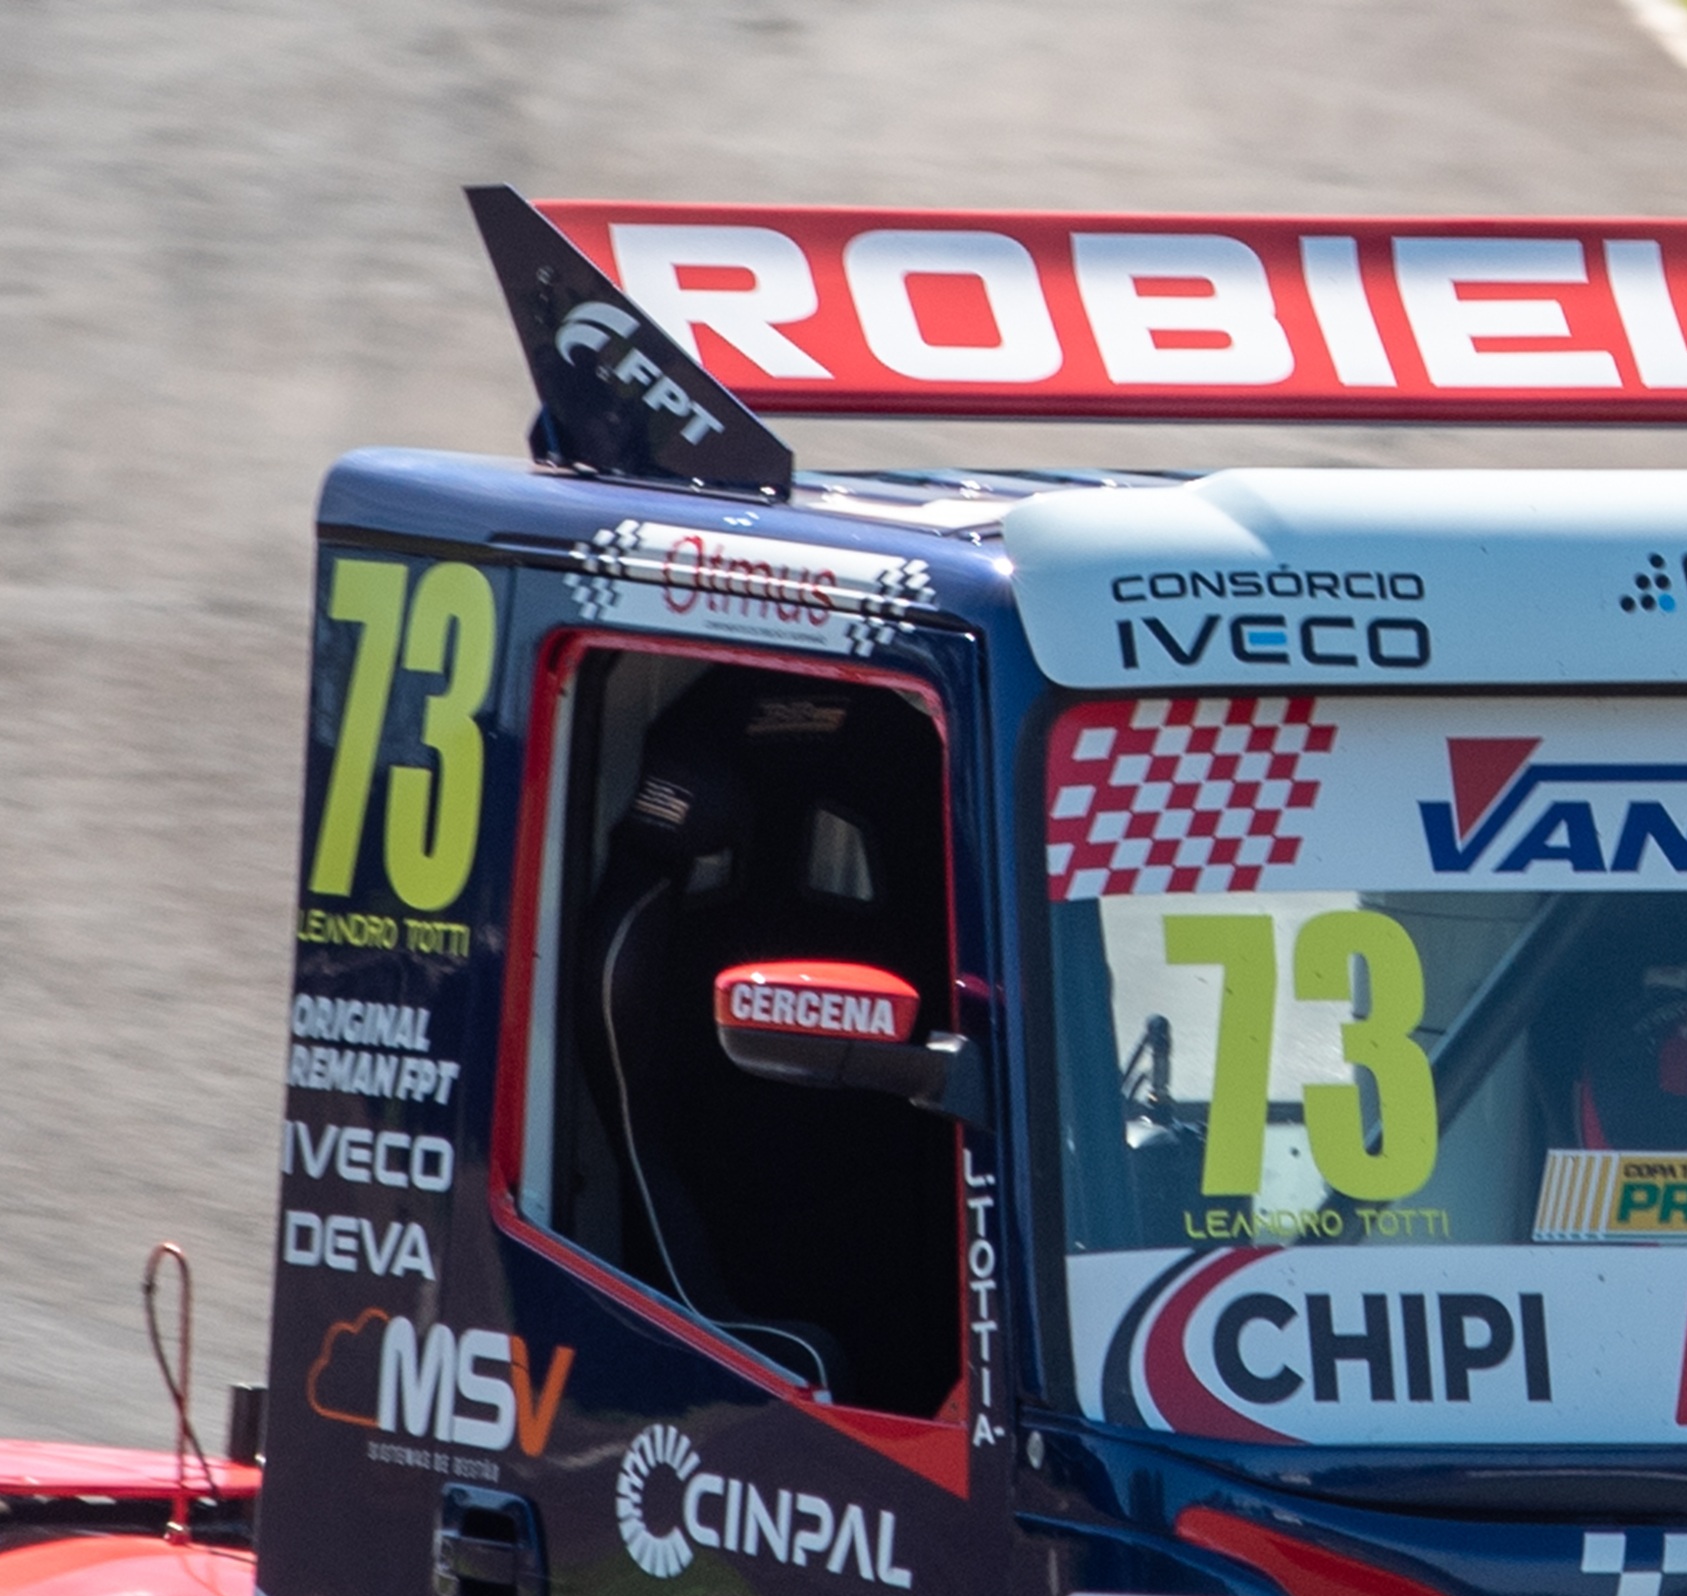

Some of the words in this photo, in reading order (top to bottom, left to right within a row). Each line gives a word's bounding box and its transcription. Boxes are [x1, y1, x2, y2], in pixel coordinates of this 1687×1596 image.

[615, 347, 725, 446] FPT
[665, 535, 837, 627] Otmus
[1111, 563, 1426, 602] CONSÓRCIO
[1116, 613, 1432, 670] IVECO
[309, 557, 497, 912] 73
[297, 908, 399, 949] LEANDRO
[403, 917, 471, 958] TOTTI
[292, 992, 431, 1053] ORIGINAL
[730, 983, 896, 1037] CERCENA
[287, 1043, 399, 1099] REMAN
[395, 1055, 461, 1106] FPT
[1161, 908, 1440, 1203] 73
[281, 1120, 455, 1193] IVECO
[1623, 1162, 1677, 1180] COPA
[282, 1209, 437, 1281] DEVA
[1183, 1208, 1344, 1240] LEANDRO
[1355, 1206, 1450, 1239] TOTTI
[1211, 1291, 1554, 1404] CHIPI
[378, 1314, 576, 1458] MSV
[683, 1473, 913, 1590] CINPAL
